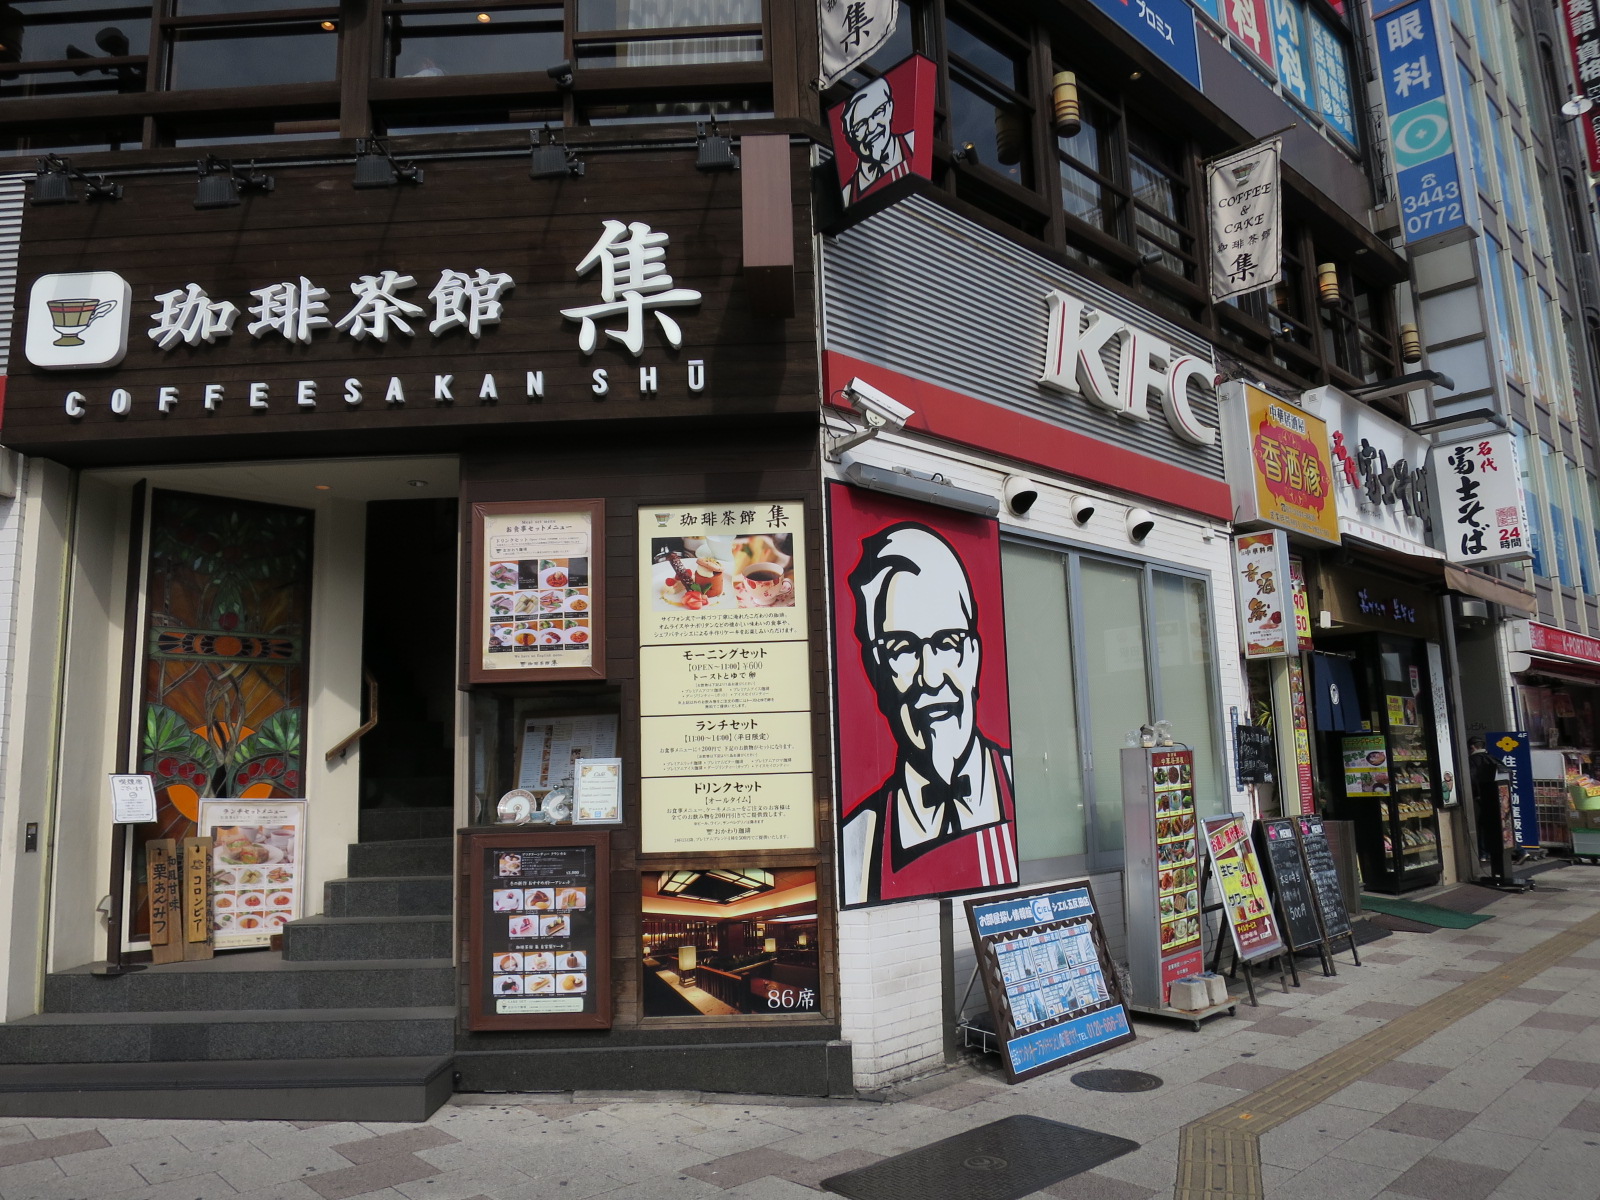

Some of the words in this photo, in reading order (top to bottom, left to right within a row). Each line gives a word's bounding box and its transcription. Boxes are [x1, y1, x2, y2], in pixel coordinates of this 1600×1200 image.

[840, 2, 874, 53] 集
[1386, 9, 1431, 98] 眼科
[1219, 183, 1271, 208] COFFEE
[1404, 182, 1459, 214] 3443
[1224, 214, 1264, 233] CAKE
[1241, 205, 1251, 215] &
[1408, 203, 1462, 234] 0772
[1228, 253, 1258, 283] 集
[148, 266, 516, 351] 珈琲茶館
[560, 219, 702, 358] 集
[1038, 289, 1215, 444] KFC
[1477, 442, 1497, 472] 名代
[1448, 447, 1490, 555] 富士そば
[680, 511, 756, 526] 珈琲茶館
[767, 505, 789, 528] 集
[1498, 527, 1520, 540] 24
[1500, 538, 1522, 549] 時間
[683, 648, 767, 661] モーニングセット
[696, 719, 758, 731] ランチセット
[694, 781, 762, 795] ドリンクセット
[193, 875, 204, 933] コロンビア
[768, 988, 815, 1011] 86席
